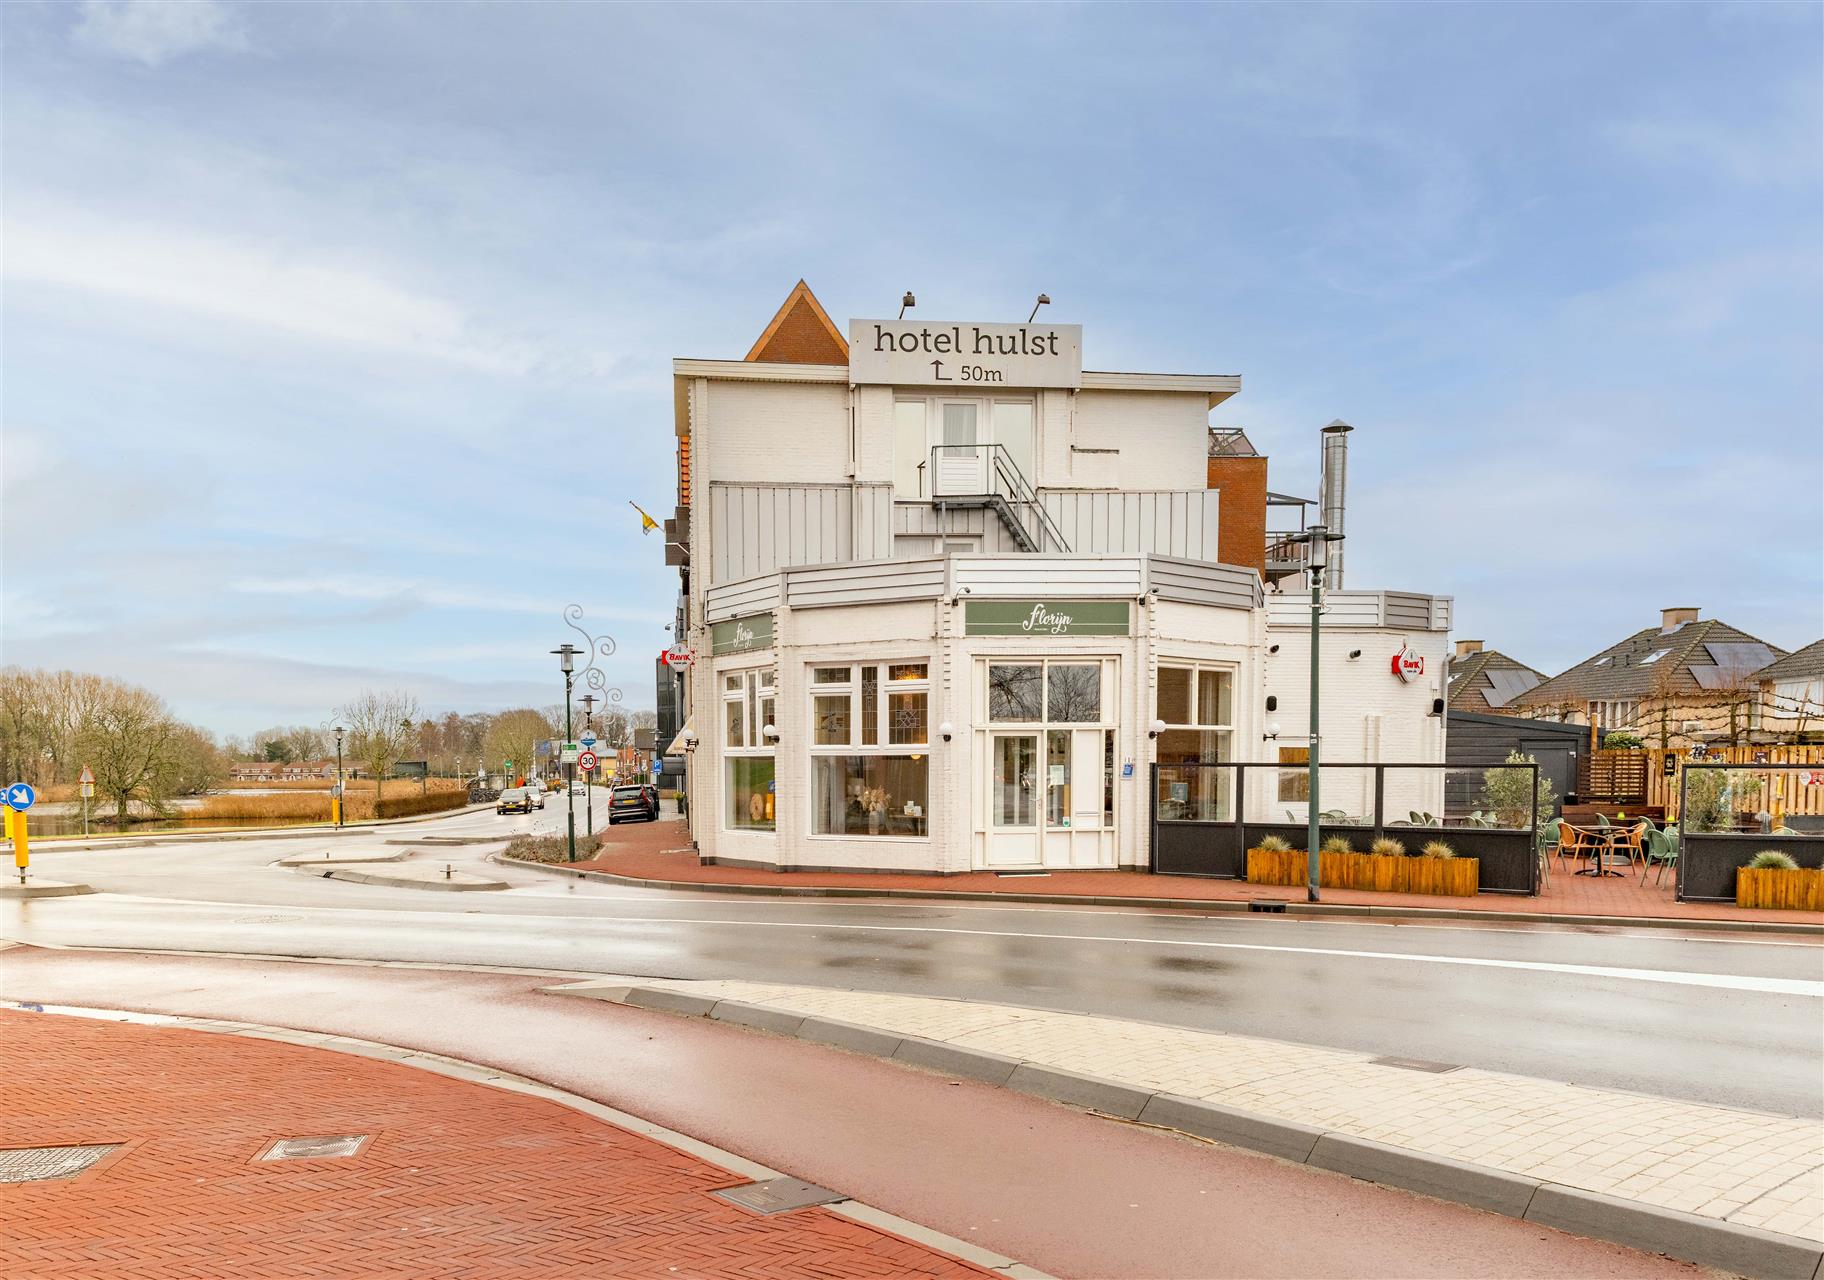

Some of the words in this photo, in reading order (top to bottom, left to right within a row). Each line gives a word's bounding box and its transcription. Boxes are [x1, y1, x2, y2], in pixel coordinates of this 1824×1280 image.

[874, 325, 962, 354] hotel
[972, 327, 1059, 356] hulst
[960, 365, 1003, 382] 50m
[582, 757, 594, 765] 30
